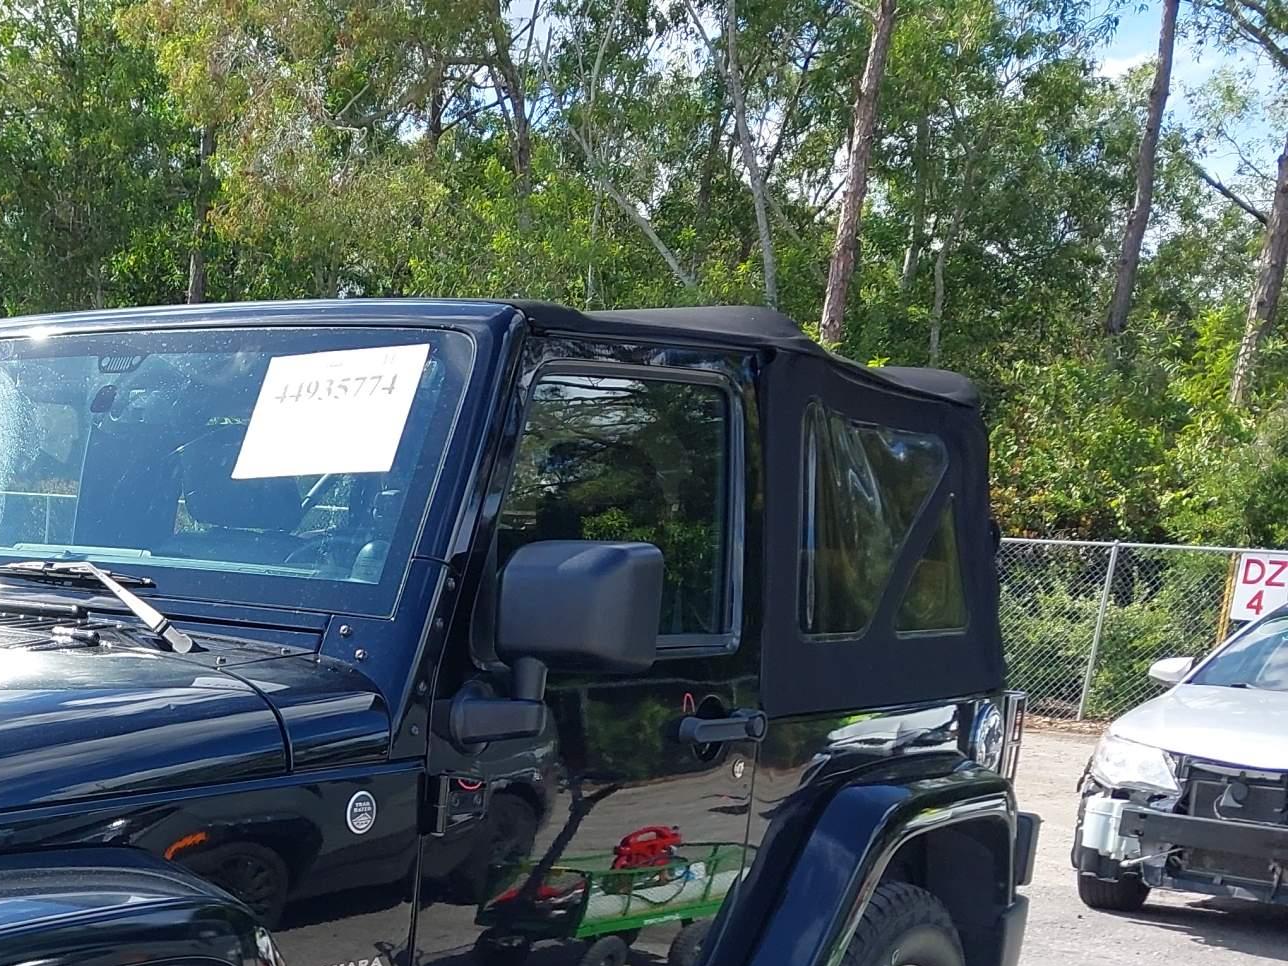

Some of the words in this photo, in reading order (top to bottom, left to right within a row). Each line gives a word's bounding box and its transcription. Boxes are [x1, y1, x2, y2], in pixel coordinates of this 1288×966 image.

[273, 373, 400, 405] 44935774
[1242, 558, 1288, 588] DZ
[1245, 589, 1265, 616] 4
